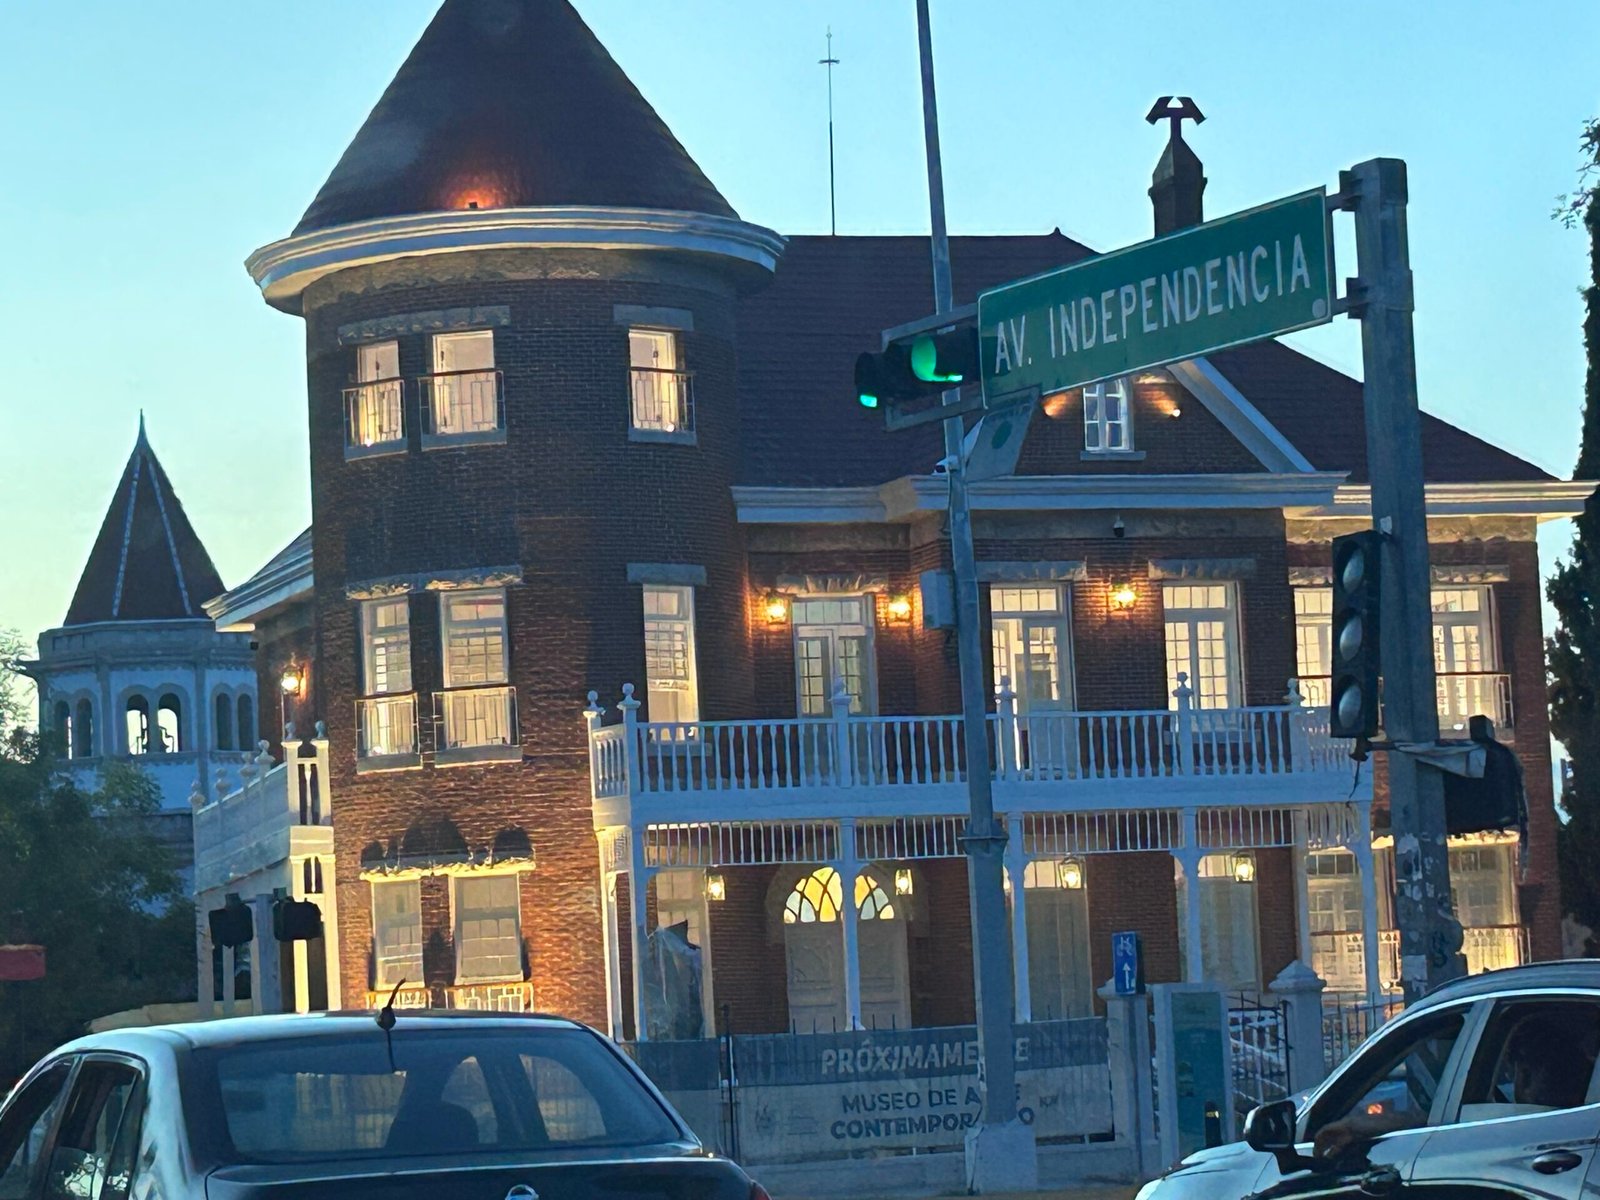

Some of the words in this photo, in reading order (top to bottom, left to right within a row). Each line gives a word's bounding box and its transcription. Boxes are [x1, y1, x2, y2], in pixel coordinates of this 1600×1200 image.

[995, 314, 1032, 374] AV.
[1049, 233, 1310, 358] INDEPENDENCIA
[821, 1036, 1030, 1075] PRÓXIMAMEE
[841, 1092, 921, 1114] MUSEO
[928, 1088, 958, 1107] DE
[830, 1106, 1035, 1140] CONTEMPORO
